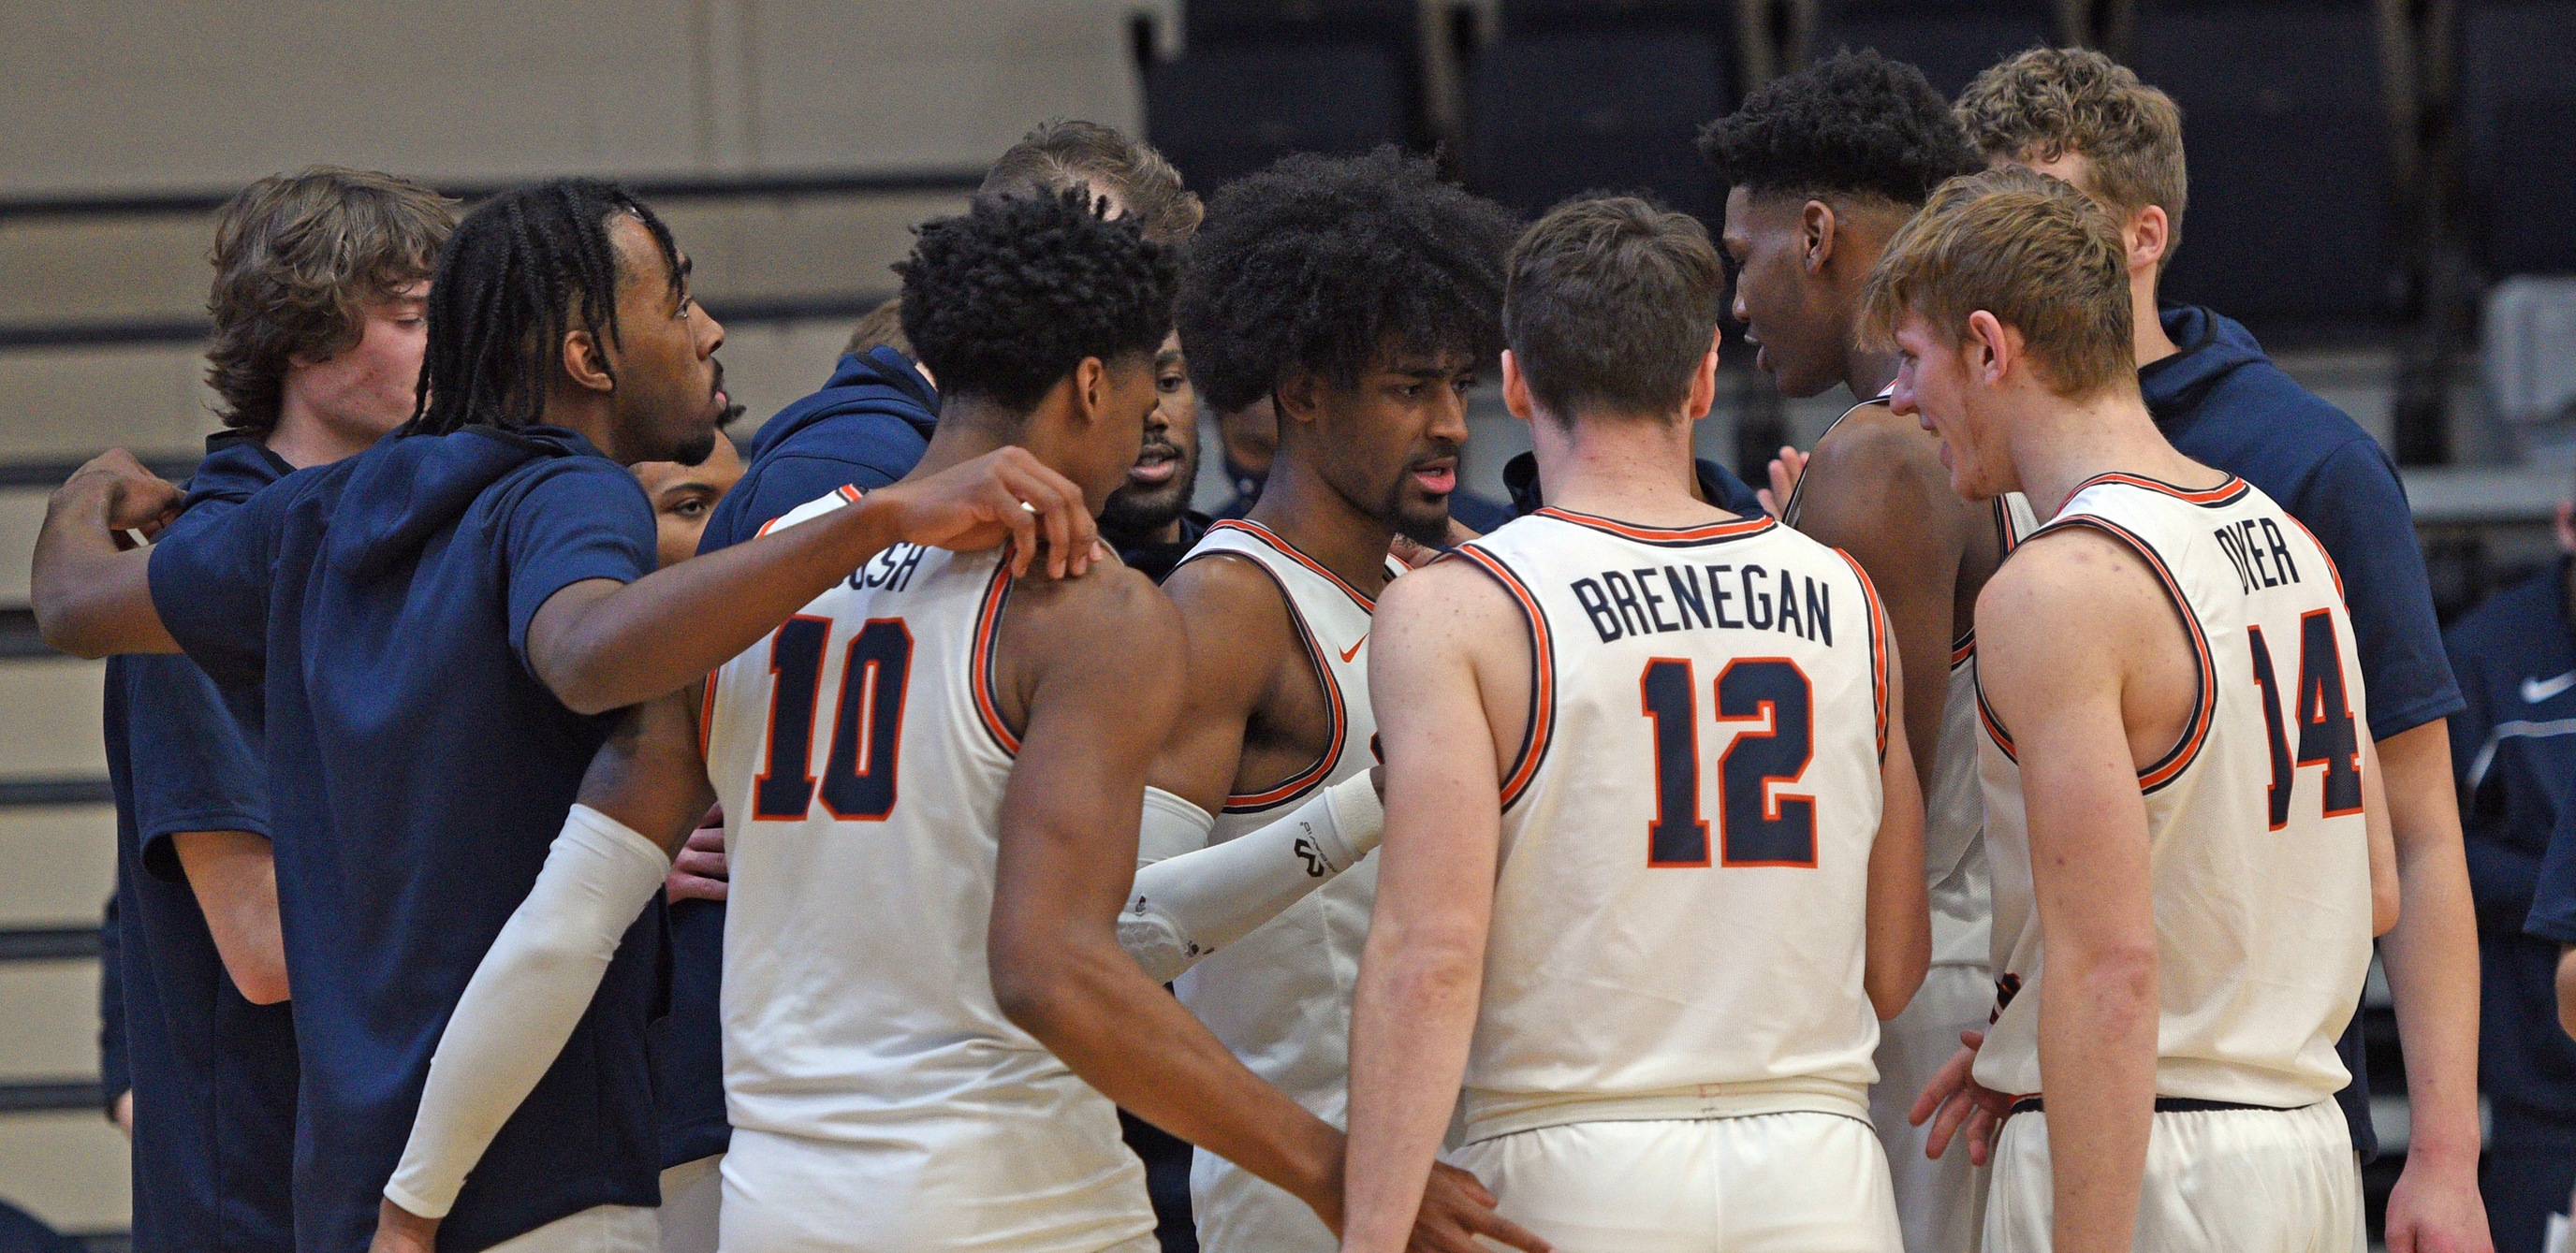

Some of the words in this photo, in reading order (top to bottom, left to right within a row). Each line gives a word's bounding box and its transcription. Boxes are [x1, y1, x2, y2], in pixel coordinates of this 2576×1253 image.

[833, 540, 928, 592] USH
[1570, 563, 1833, 648] BRENEGAN
[2214, 517, 2301, 596] DYER
[752, 613, 915, 822] 10
[1639, 656, 1819, 869] 12
[2247, 606, 2364, 832] 14
